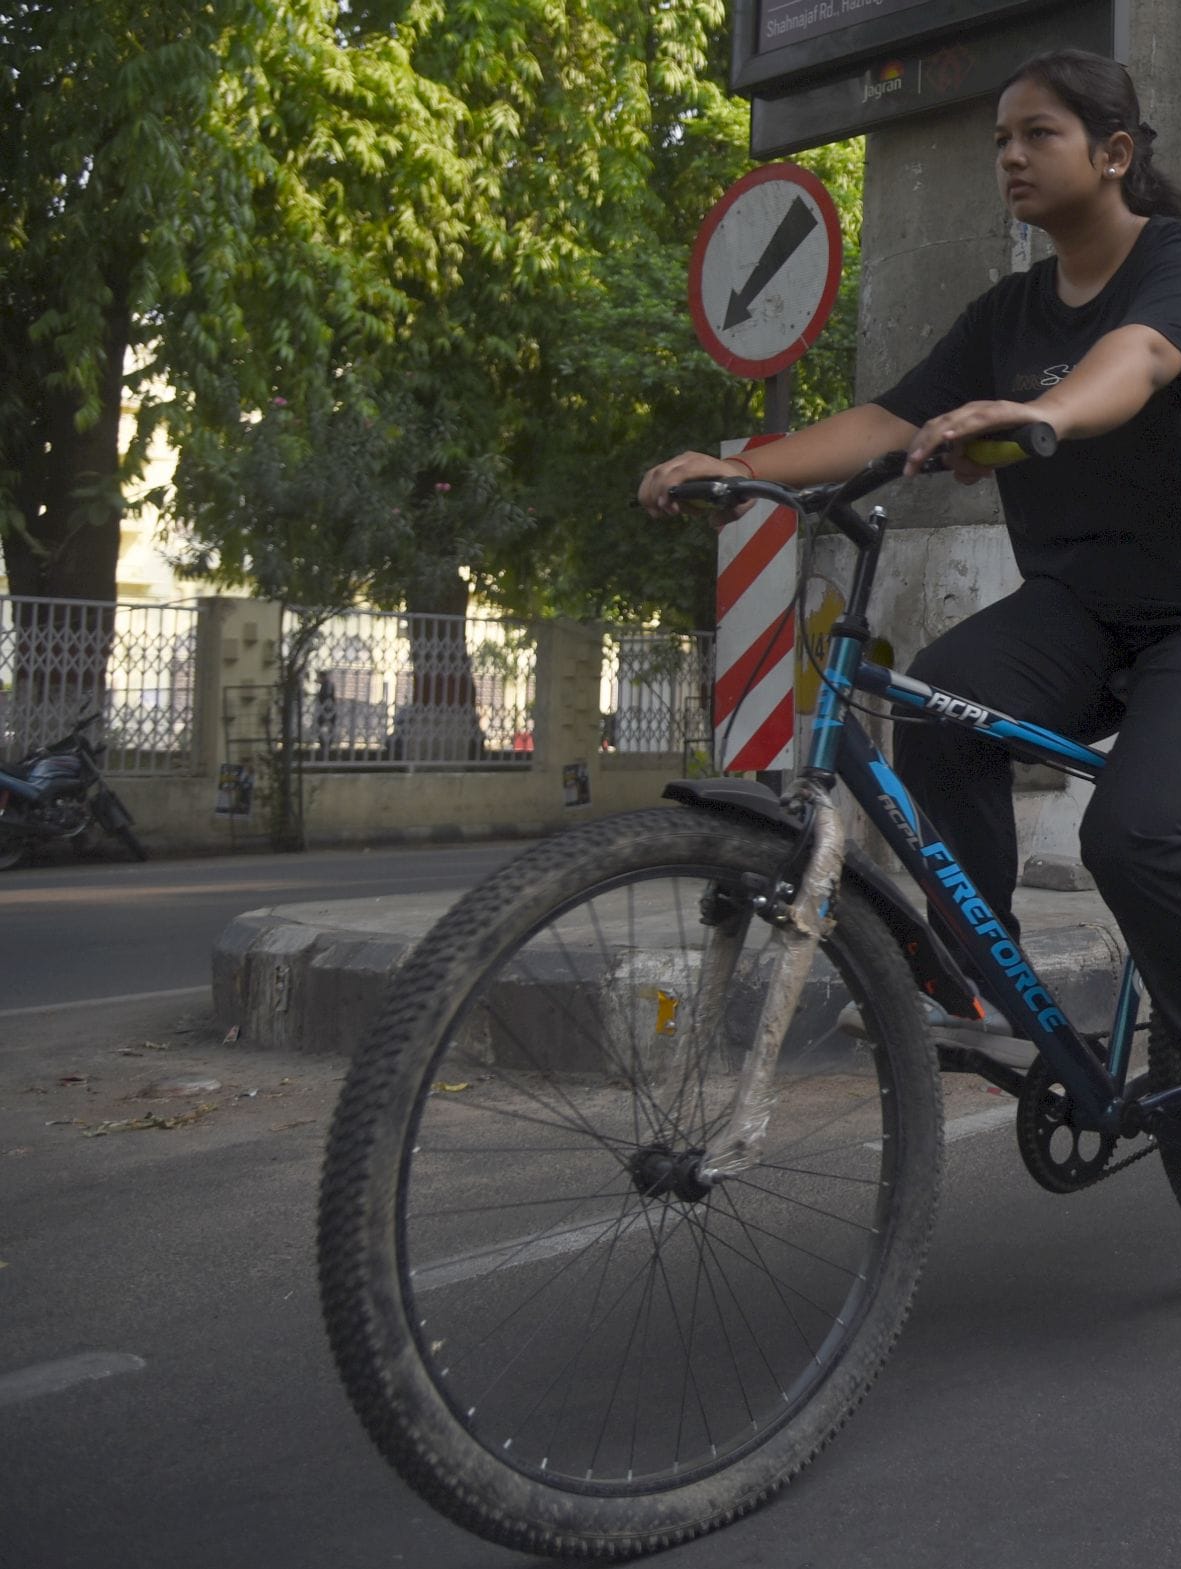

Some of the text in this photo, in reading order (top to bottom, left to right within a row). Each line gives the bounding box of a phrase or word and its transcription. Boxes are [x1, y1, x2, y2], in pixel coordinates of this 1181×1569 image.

[766, 6, 818, 38] Shahnajaf
[862, 78, 902, 104] Jagran
[926, 692, 991, 729] ACPL
[876, 794, 919, 851] ACPL
[920, 841, 1068, 1033] FIREFORCE
